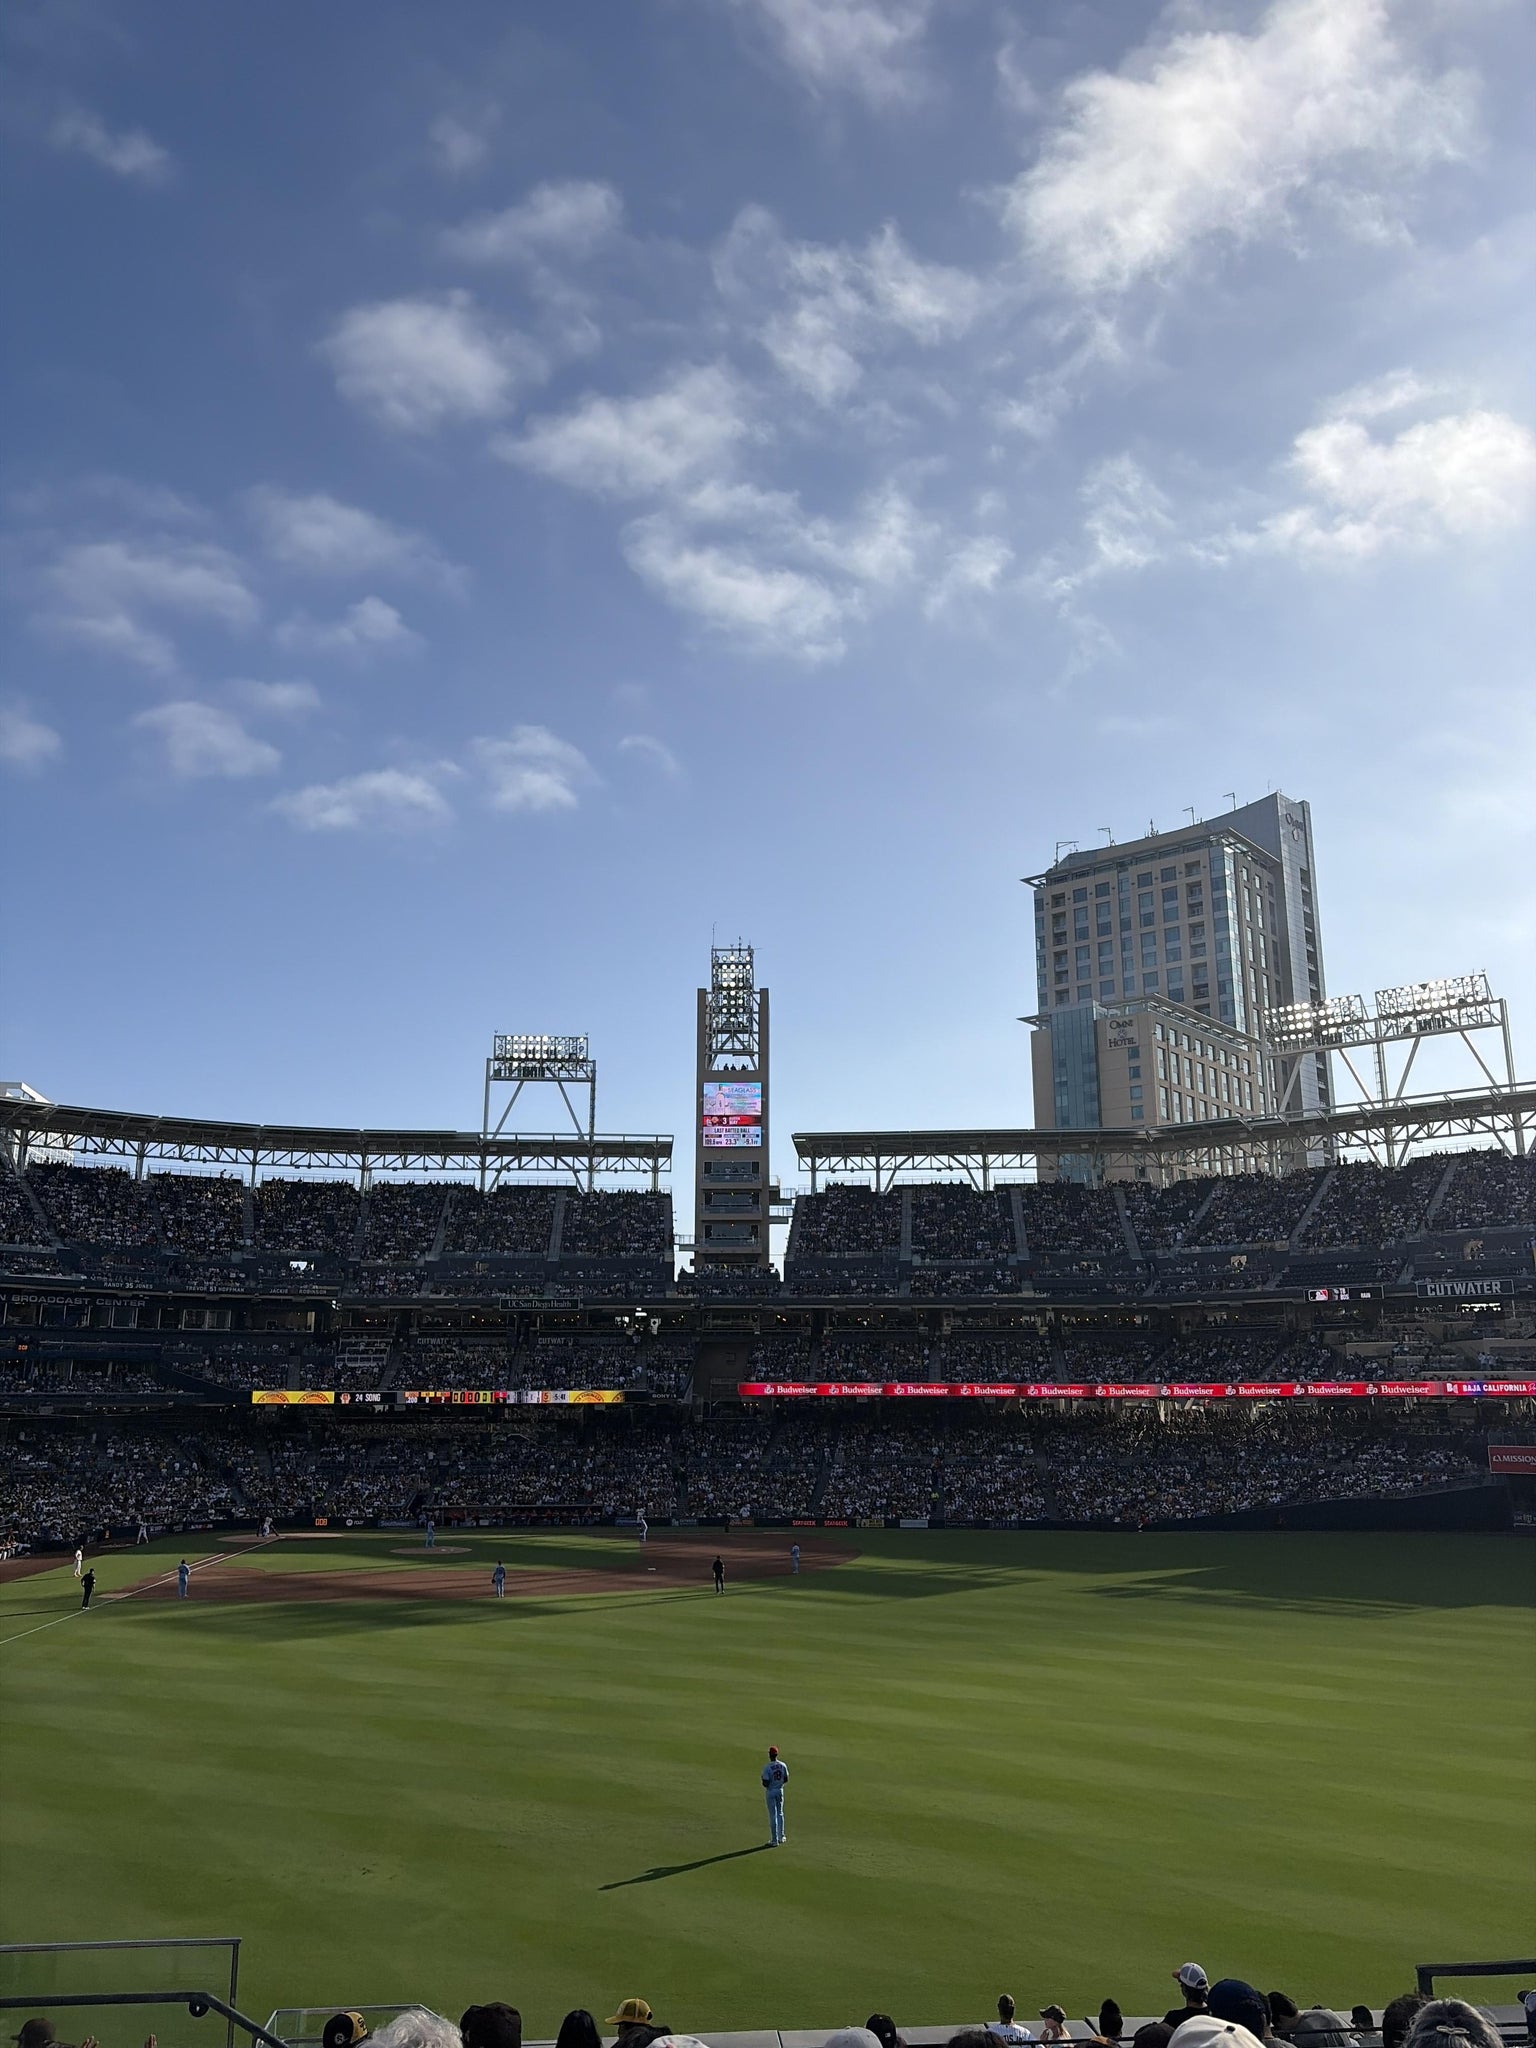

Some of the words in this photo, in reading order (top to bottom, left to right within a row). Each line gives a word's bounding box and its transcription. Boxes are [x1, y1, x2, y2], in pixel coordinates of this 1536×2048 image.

[1426, 1281, 1502, 1297] CUTWATER
[11, 1294, 91, 1306] BROADCAST
[95, 1298, 147, 1308] CENTER
[519, 1300, 532, 1308] San
[776, 1386, 817, 1394] Budweiser
[842, 1386, 882, 1394] Budweiser
[907, 1386, 949, 1394] Budweiser
[974, 1386, 1016, 1395] Budweiser
[1041, 1387, 1084, 1395] Budweiser
[1109, 1387, 1150, 1395] Budweiser
[1173, 1387, 1214, 1395] Budweiser
[1238, 1386, 1281, 1395] Budweiser
[1307, 1385, 1353, 1394] Budweiser
[1381, 1385, 1430, 1394] Budweiser
[1482, 1384, 1527, 1392] CALIFORNIA
[355, 1394, 363, 1402] 24
[365, 1394, 381, 1402] SONG
[1502, 1455, 1536, 1463] MISSION
